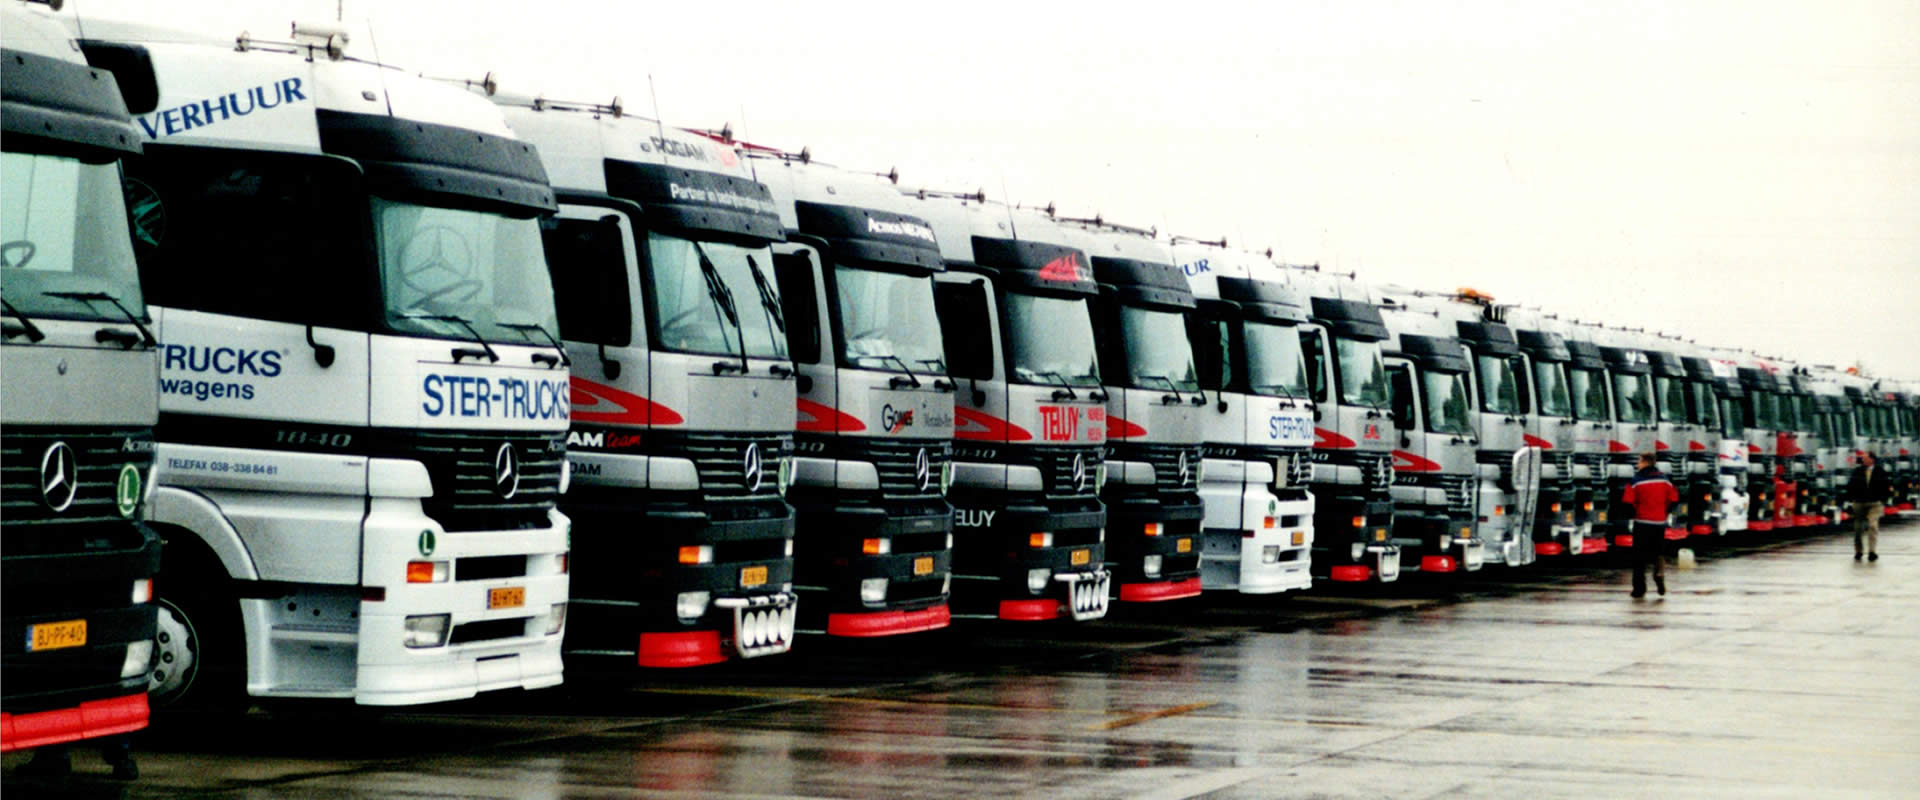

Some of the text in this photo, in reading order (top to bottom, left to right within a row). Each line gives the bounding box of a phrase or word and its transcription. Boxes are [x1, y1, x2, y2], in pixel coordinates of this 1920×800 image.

[137, 77, 307, 139] VERHUUR
[1178, 258, 1211, 277] UR
[160, 378, 255, 401] wagens
[423, 374, 569, 420] STER-TRUCKS
[275, 429, 352, 448] 1840
[606, 432, 641, 448] team
[168, 458, 207, 470] TELEFAX
